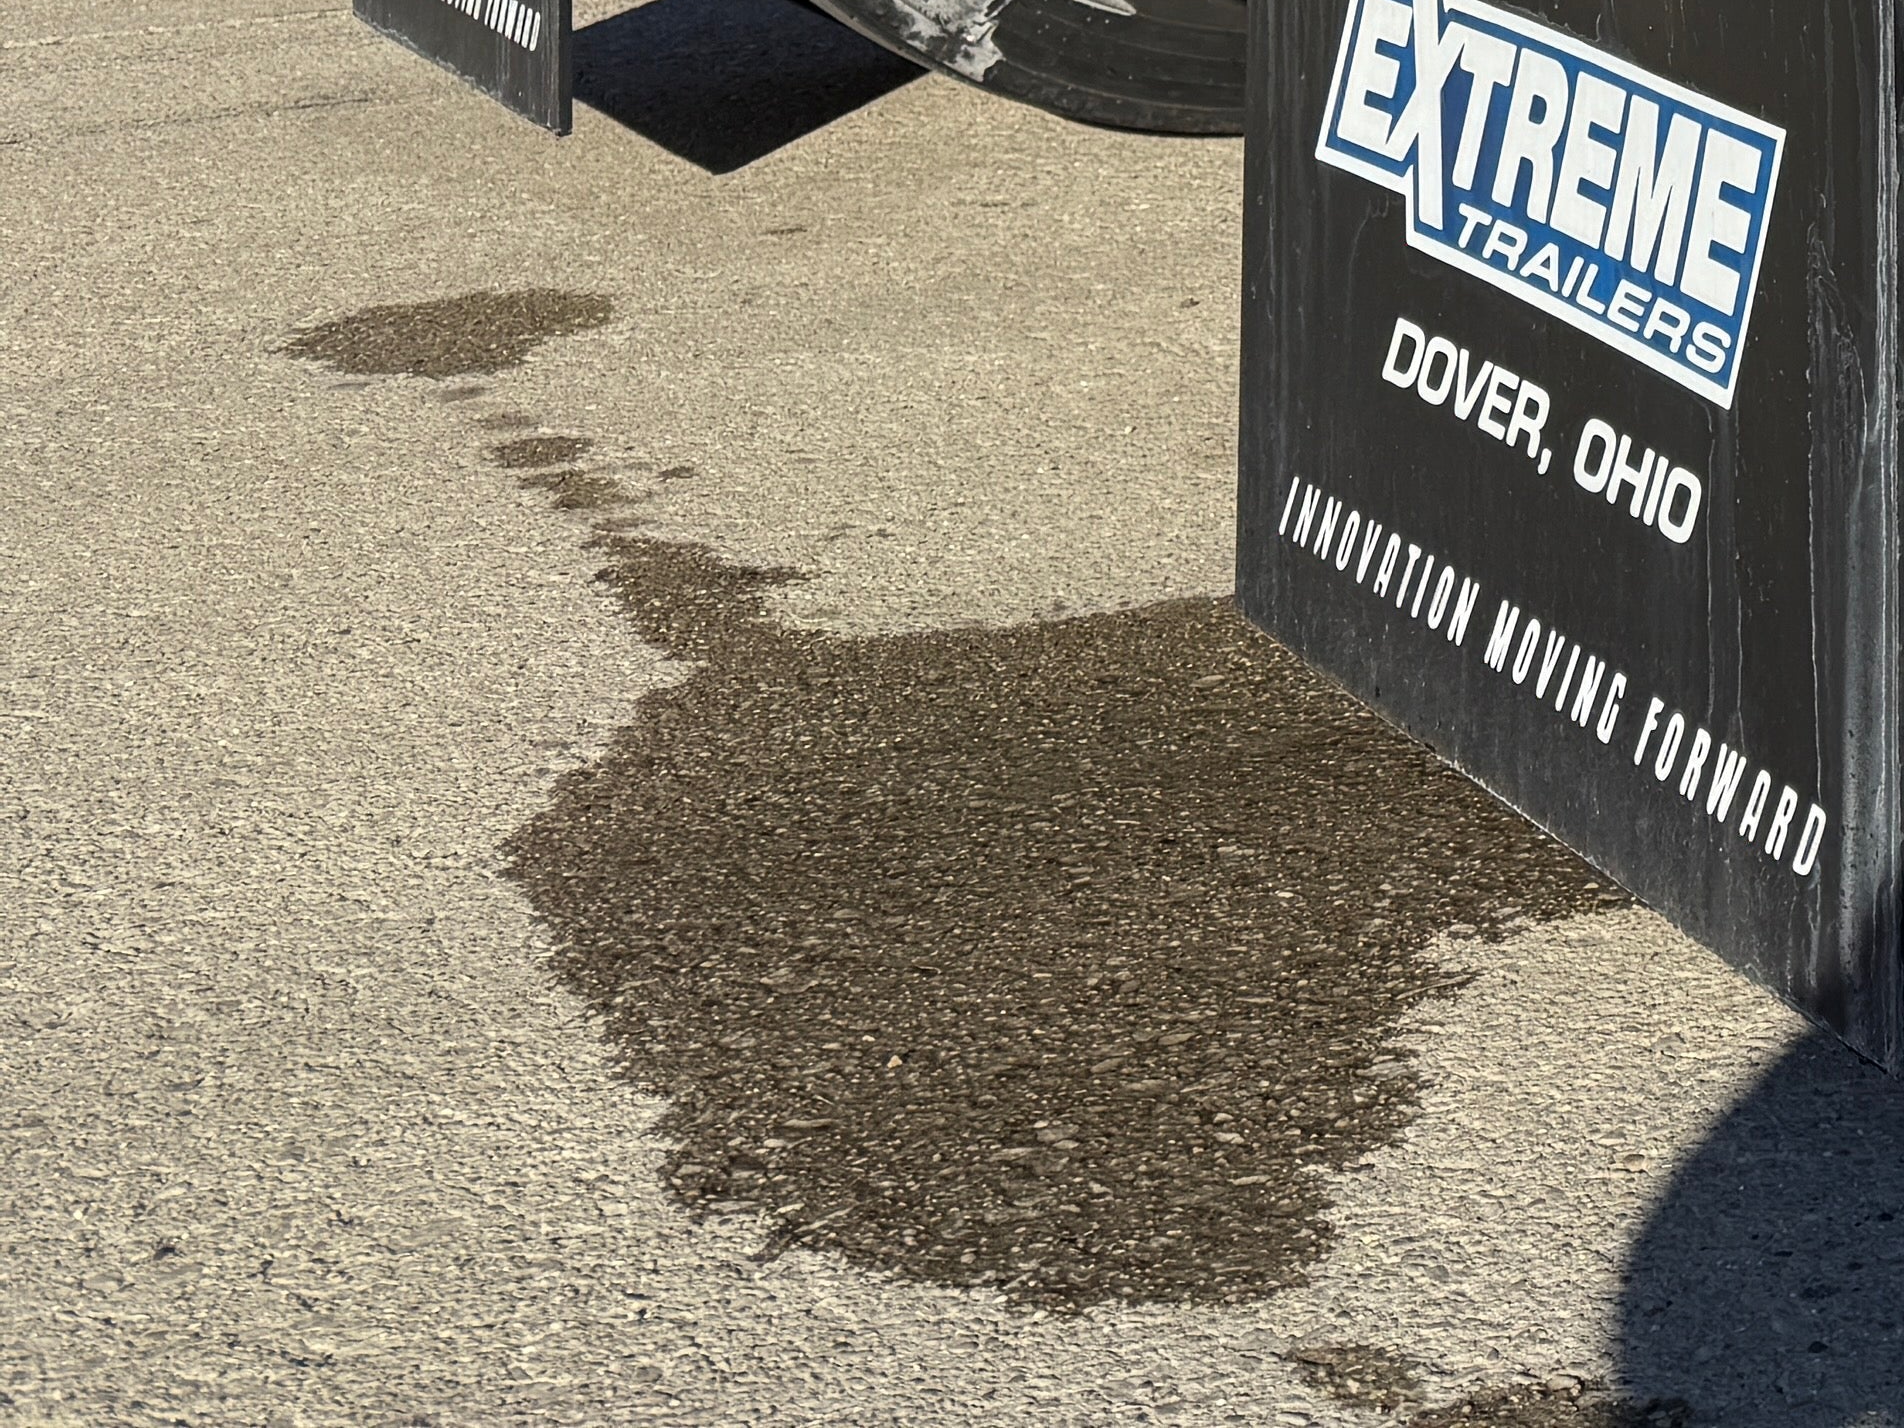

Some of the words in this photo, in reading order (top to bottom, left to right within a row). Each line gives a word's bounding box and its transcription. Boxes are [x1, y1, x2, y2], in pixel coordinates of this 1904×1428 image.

[1457, 203, 1732, 375] TRAILERS
[1381, 317, 1553, 475] DOVER,
[1573, 418, 1702, 544] OHIO
[1279, 476, 1480, 646] INNOVATION
[1484, 600, 1627, 745] MOVING
[1633, 697, 1827, 876] FORWARD
